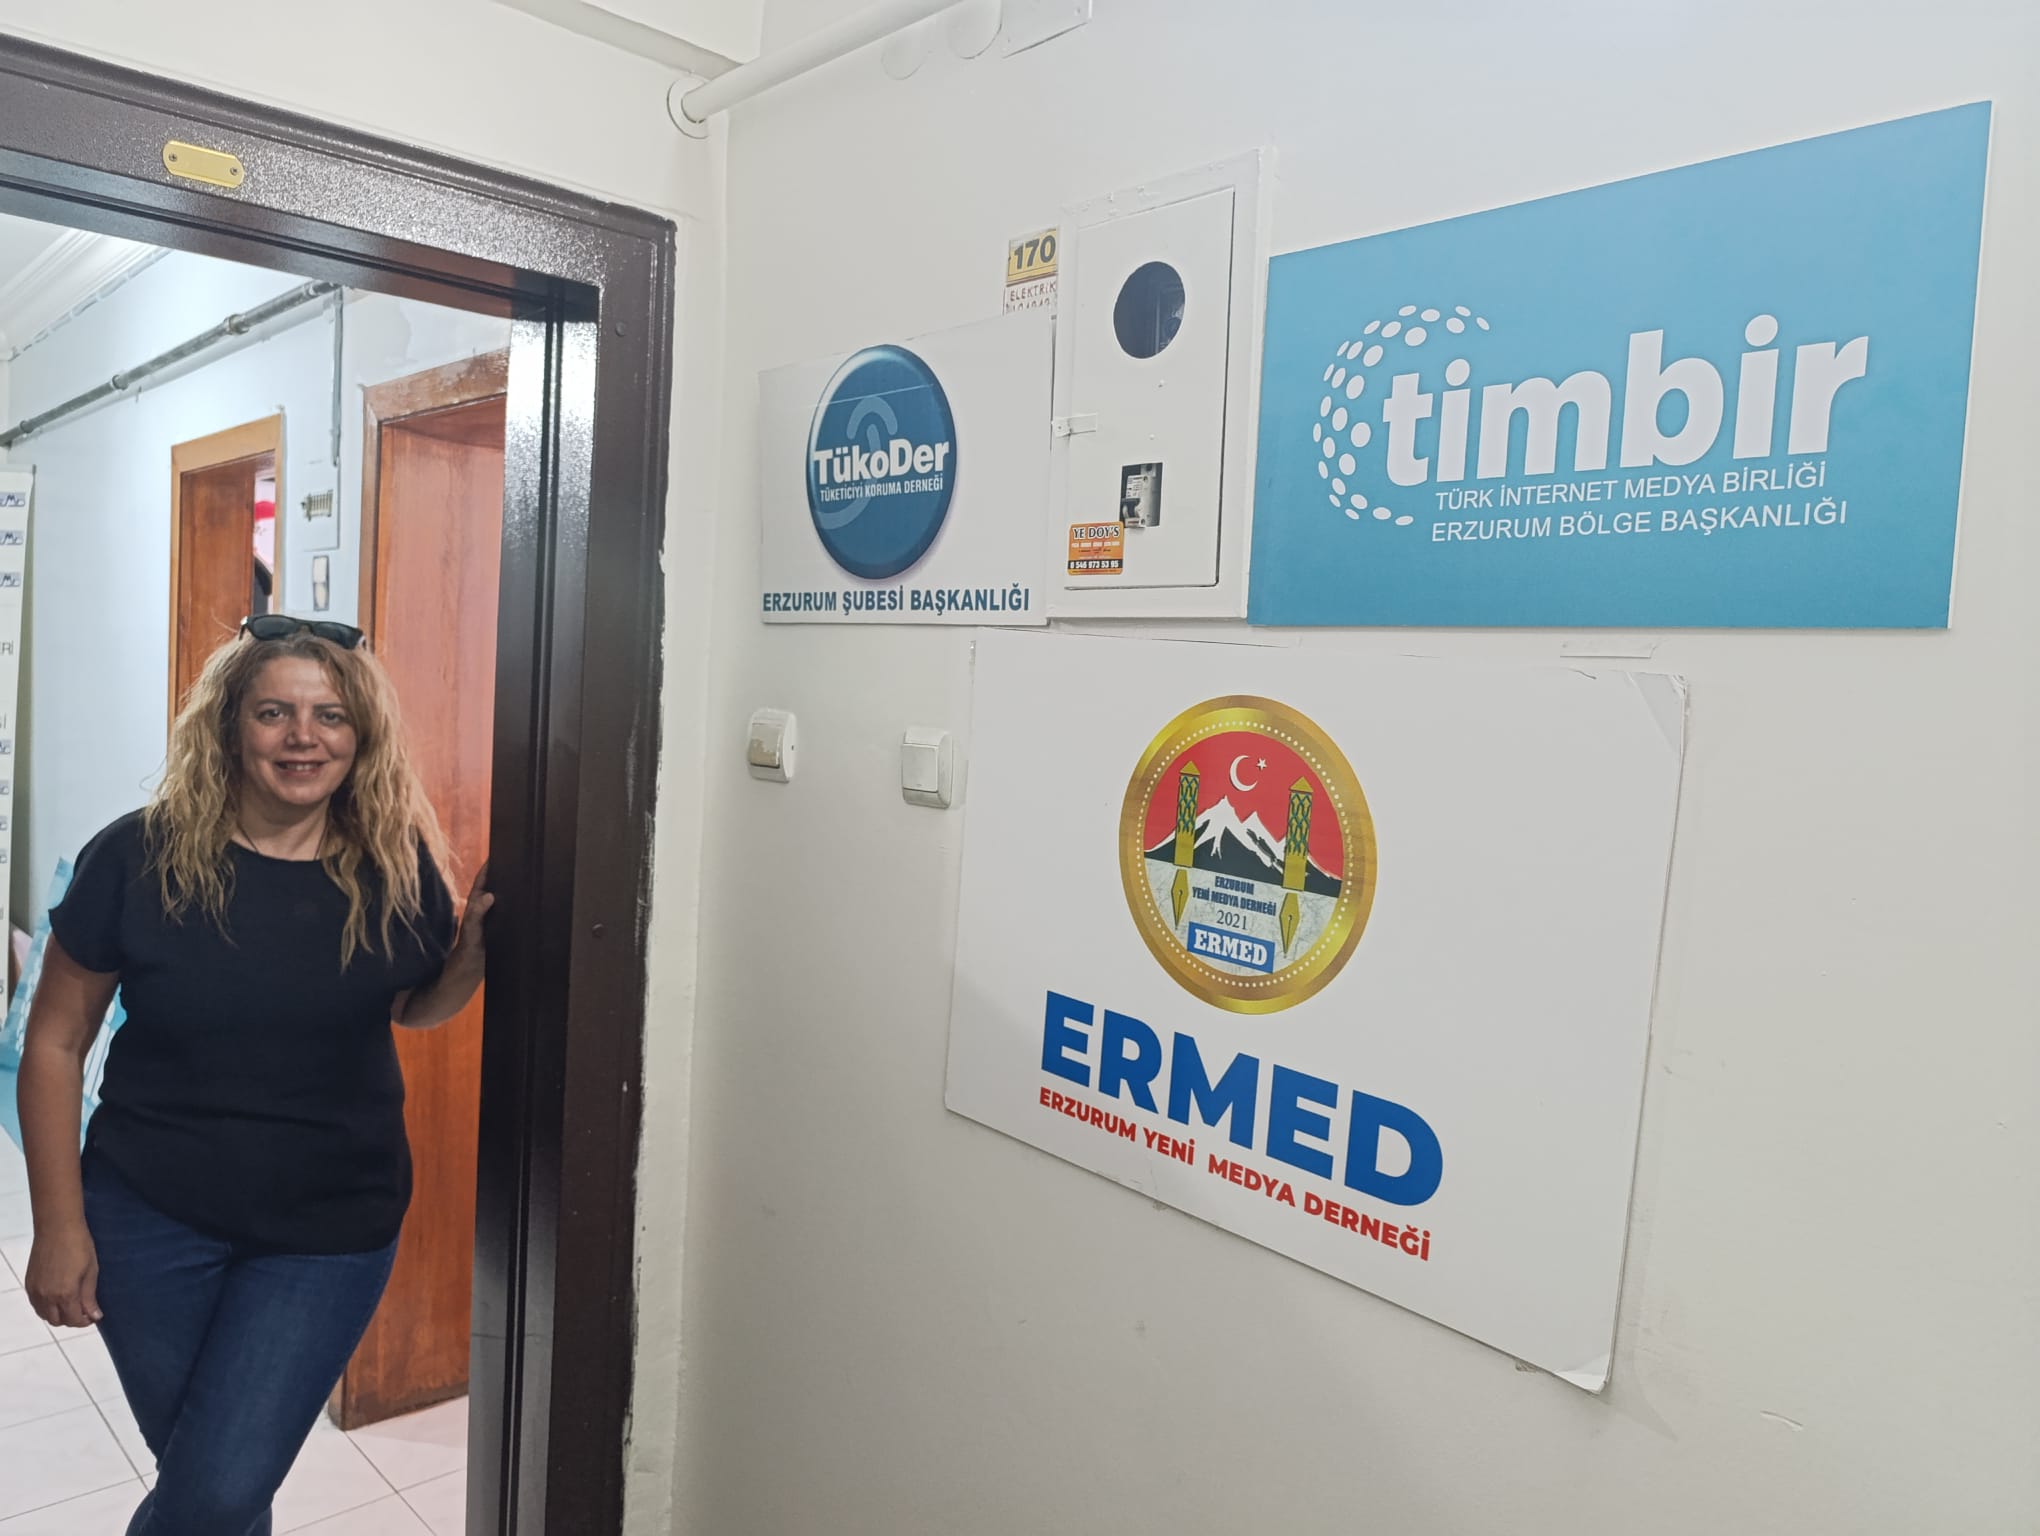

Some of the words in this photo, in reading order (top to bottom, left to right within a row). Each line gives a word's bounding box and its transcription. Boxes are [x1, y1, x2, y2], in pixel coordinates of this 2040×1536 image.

[1014, 234, 1056, 270] 170
[1382, 314, 1869, 487] timbir
[813, 438, 949, 485] TükoDer
[865, 481, 902, 498] KORUMA
[904, 473, 943, 494] DERNEĞİ
[1436, 488, 1494, 511] TÜRK
[1500, 480, 1619, 508] İNTERNET
[1624, 472, 1712, 500] MEDYA
[1722, 460, 1827, 492] BİRLİĞİ
[1431, 516, 1551, 543] ERZURUM
[1559, 511, 1652, 537] BÖLGE
[1660, 496, 1848, 535] BAŞKANLIĞI
[762, 591, 837, 612] ERZURUM
[842, 585, 904, 616] ŞUBESİ
[910, 582, 1029, 616] BAŞKANLIĞI
[1192, 886, 1210, 901] YENİ
[1210, 890, 1240, 908] MEDYA
[1240, 896, 1277, 917] DERNEĞİ
[1214, 875, 1255, 895] ERZURUM
[1216, 909, 1248, 931] 2021
[1193, 928, 1269, 966] ERMED
[1041, 990, 1443, 1207] ERMED
[1039, 1086, 1137, 1143] ERZURUM
[1143, 1126, 1196, 1166] YENİ
[1207, 1153, 1297, 1208] MEDYA
[1303, 1191, 1432, 1262] DERNEĞİ
